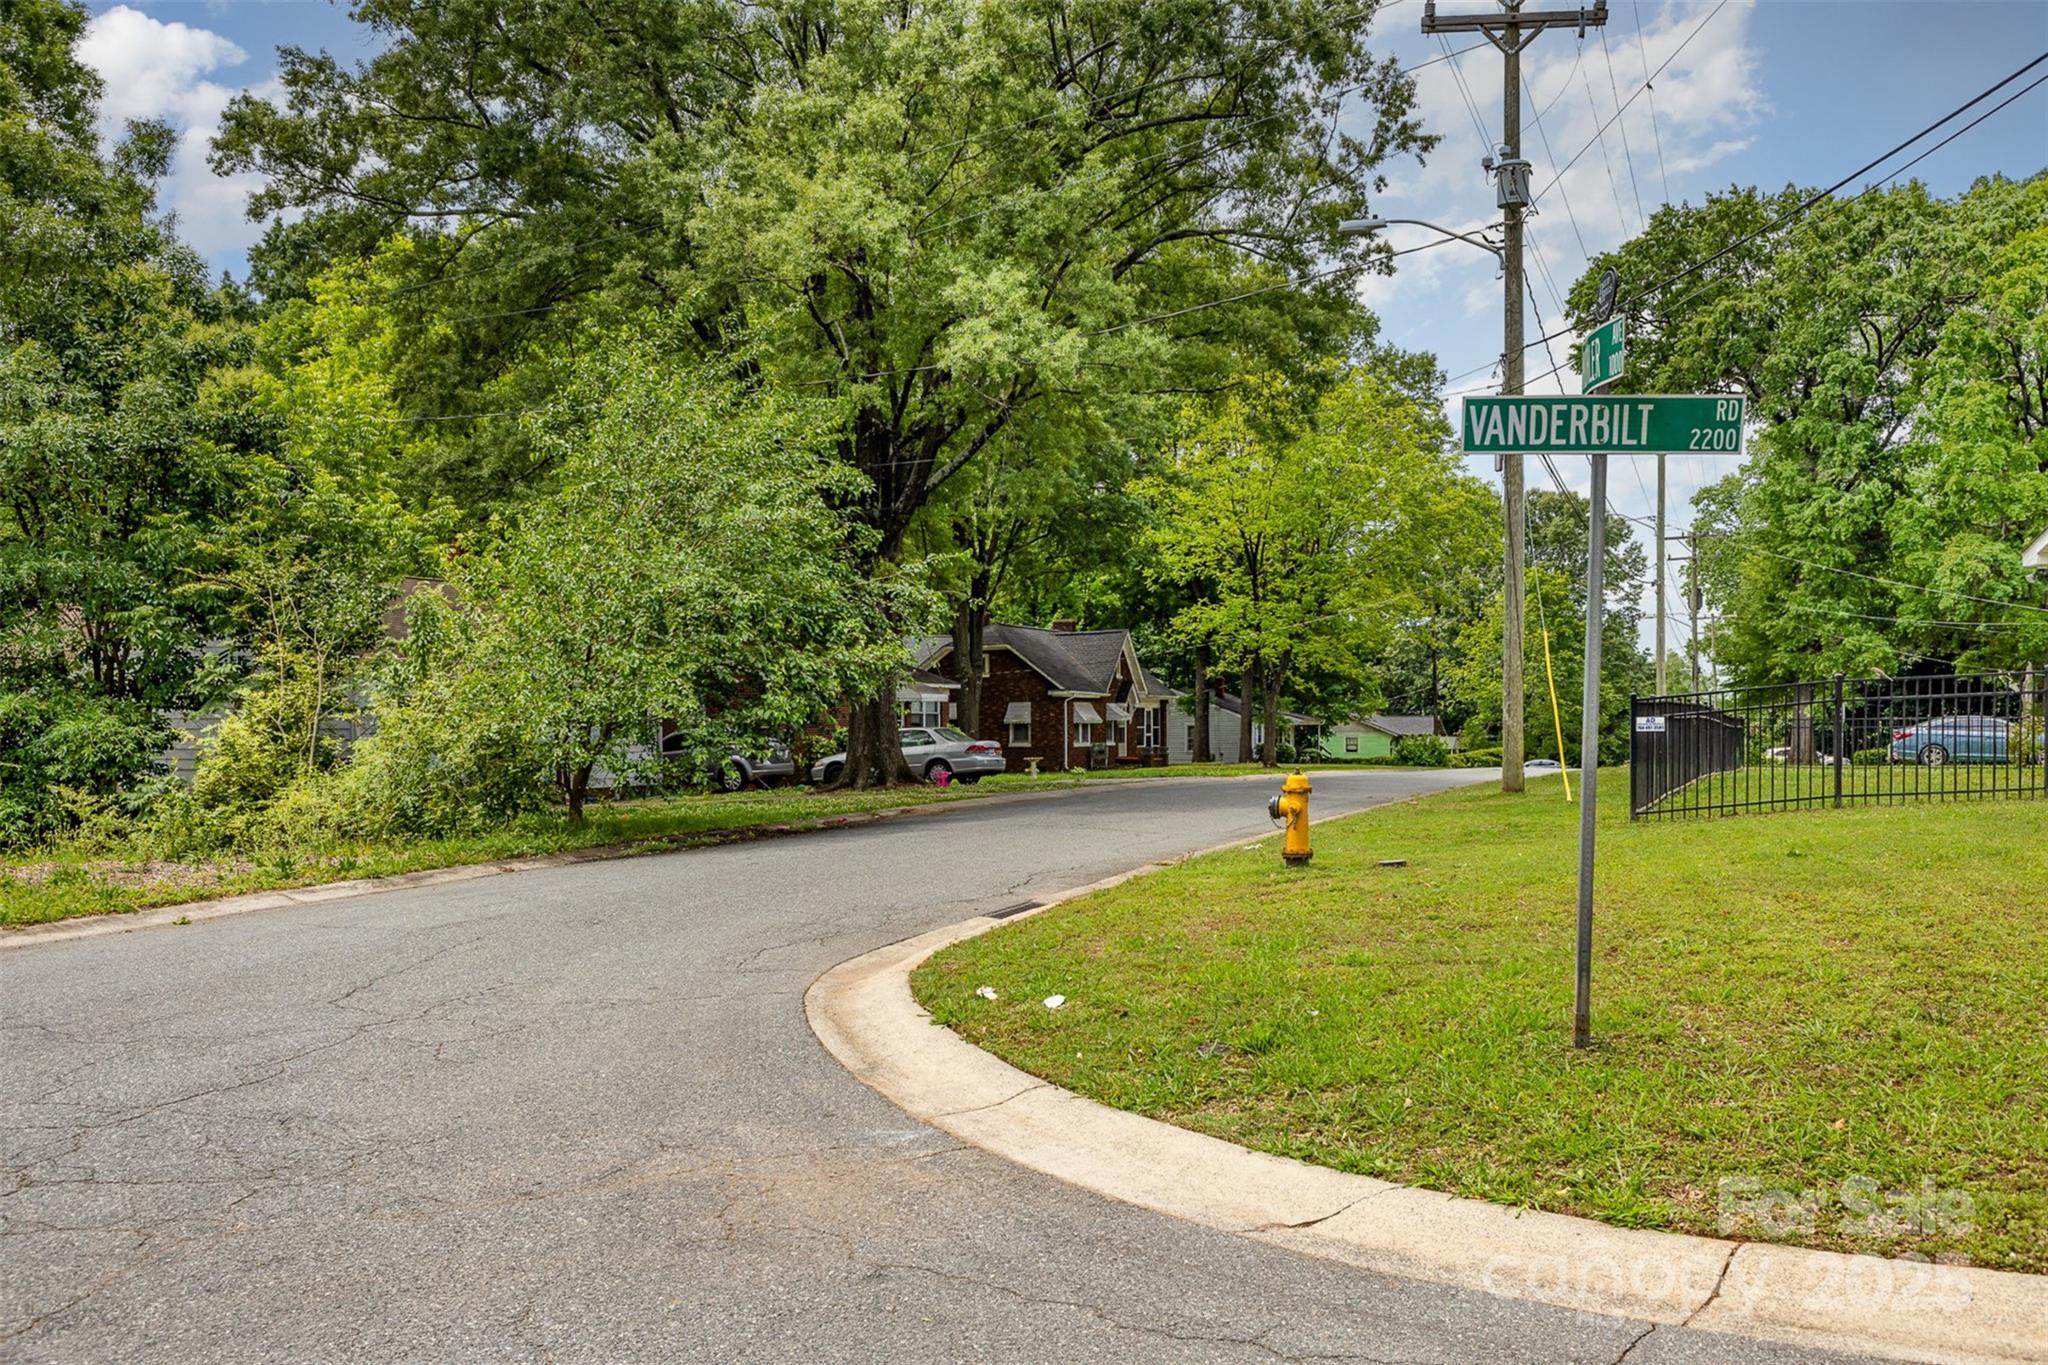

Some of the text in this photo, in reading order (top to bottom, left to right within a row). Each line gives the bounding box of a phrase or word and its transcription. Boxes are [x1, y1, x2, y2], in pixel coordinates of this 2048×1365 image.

[1612, 320, 1622, 345] AVE
[1469, 400, 1738, 446] VANDERBILT RD
[1689, 428, 1737, 450] 2200
